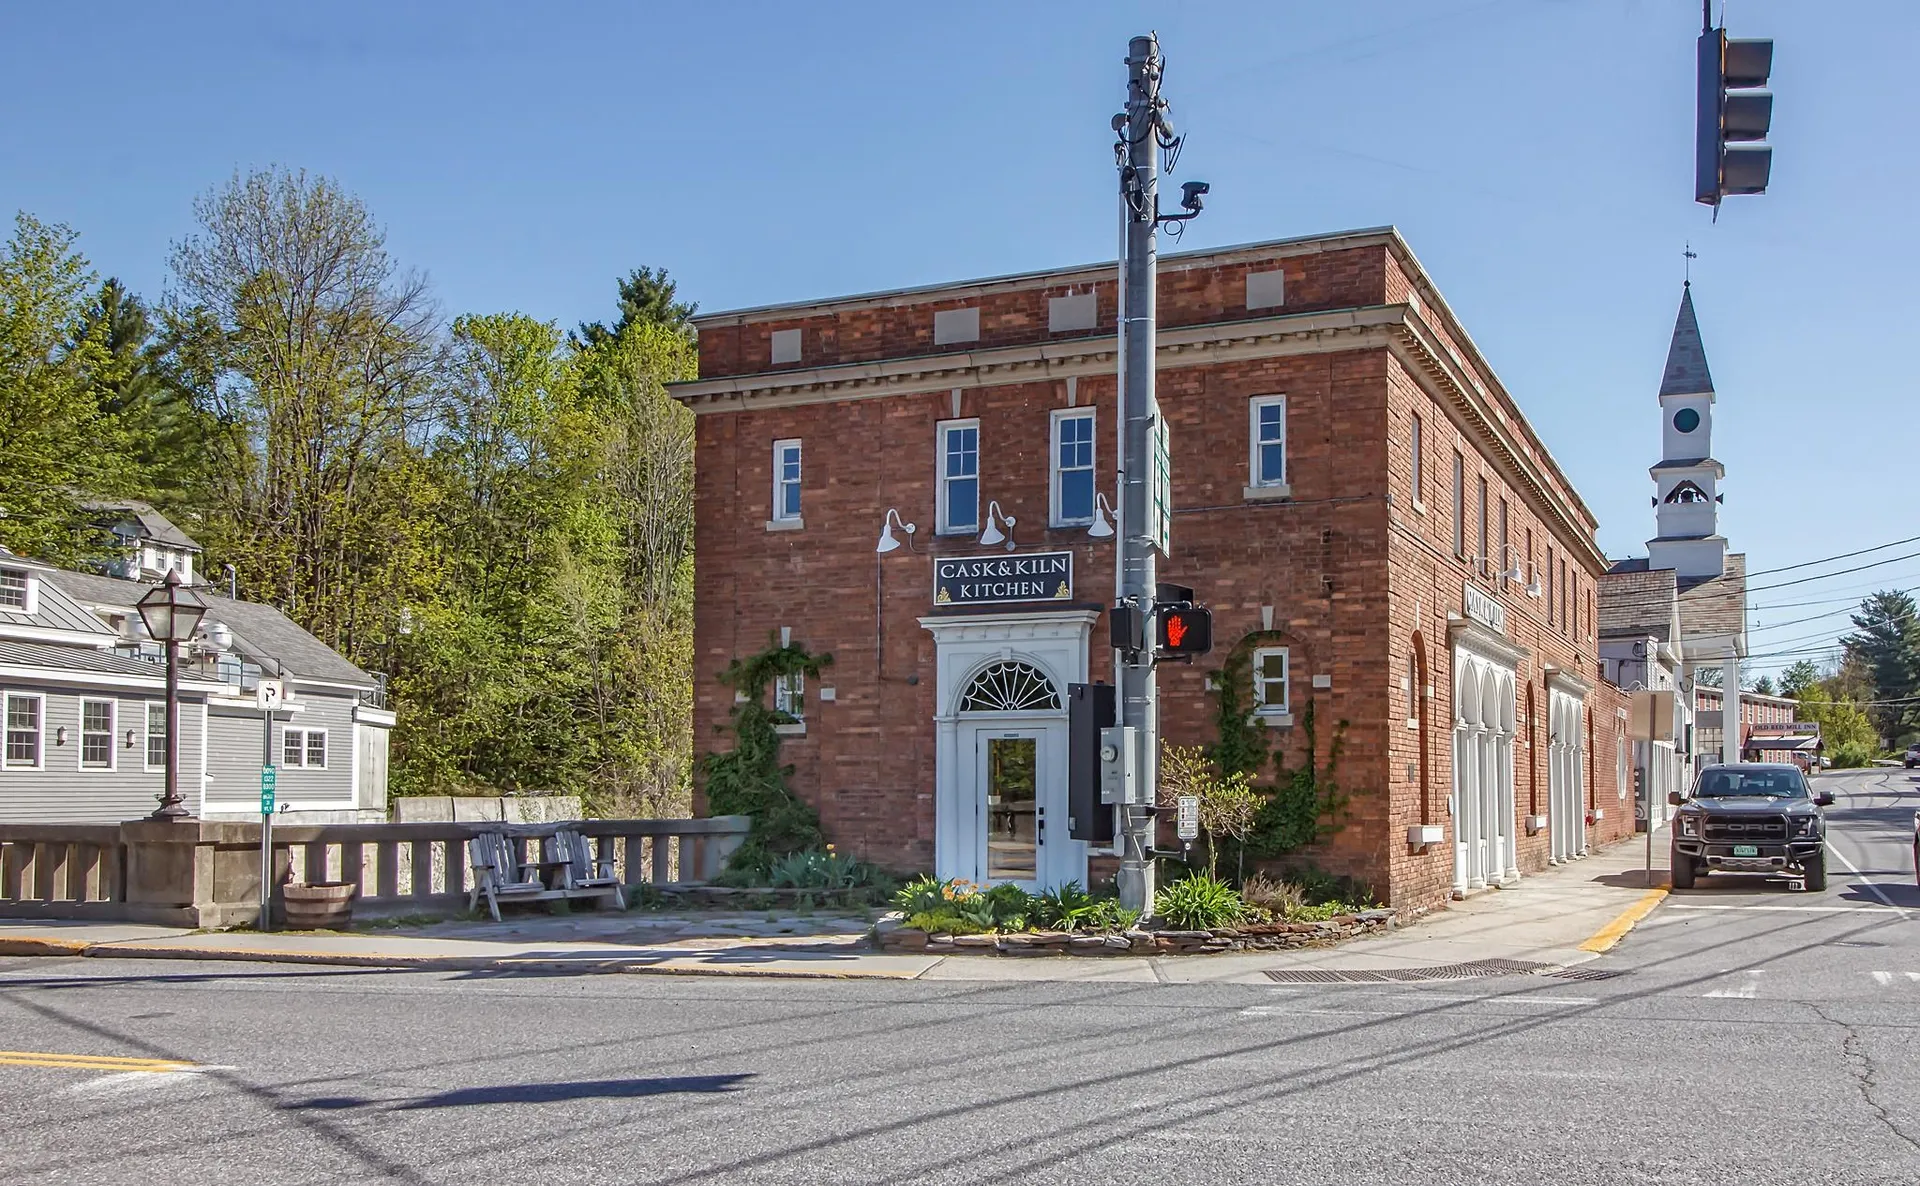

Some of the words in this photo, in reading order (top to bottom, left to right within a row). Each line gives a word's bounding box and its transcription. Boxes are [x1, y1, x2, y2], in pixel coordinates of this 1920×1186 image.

[940, 558, 1068, 579] CASK&KILN
[960, 581, 1045, 598] KITCHEN
[1705, 823, 1784, 831] FORD
